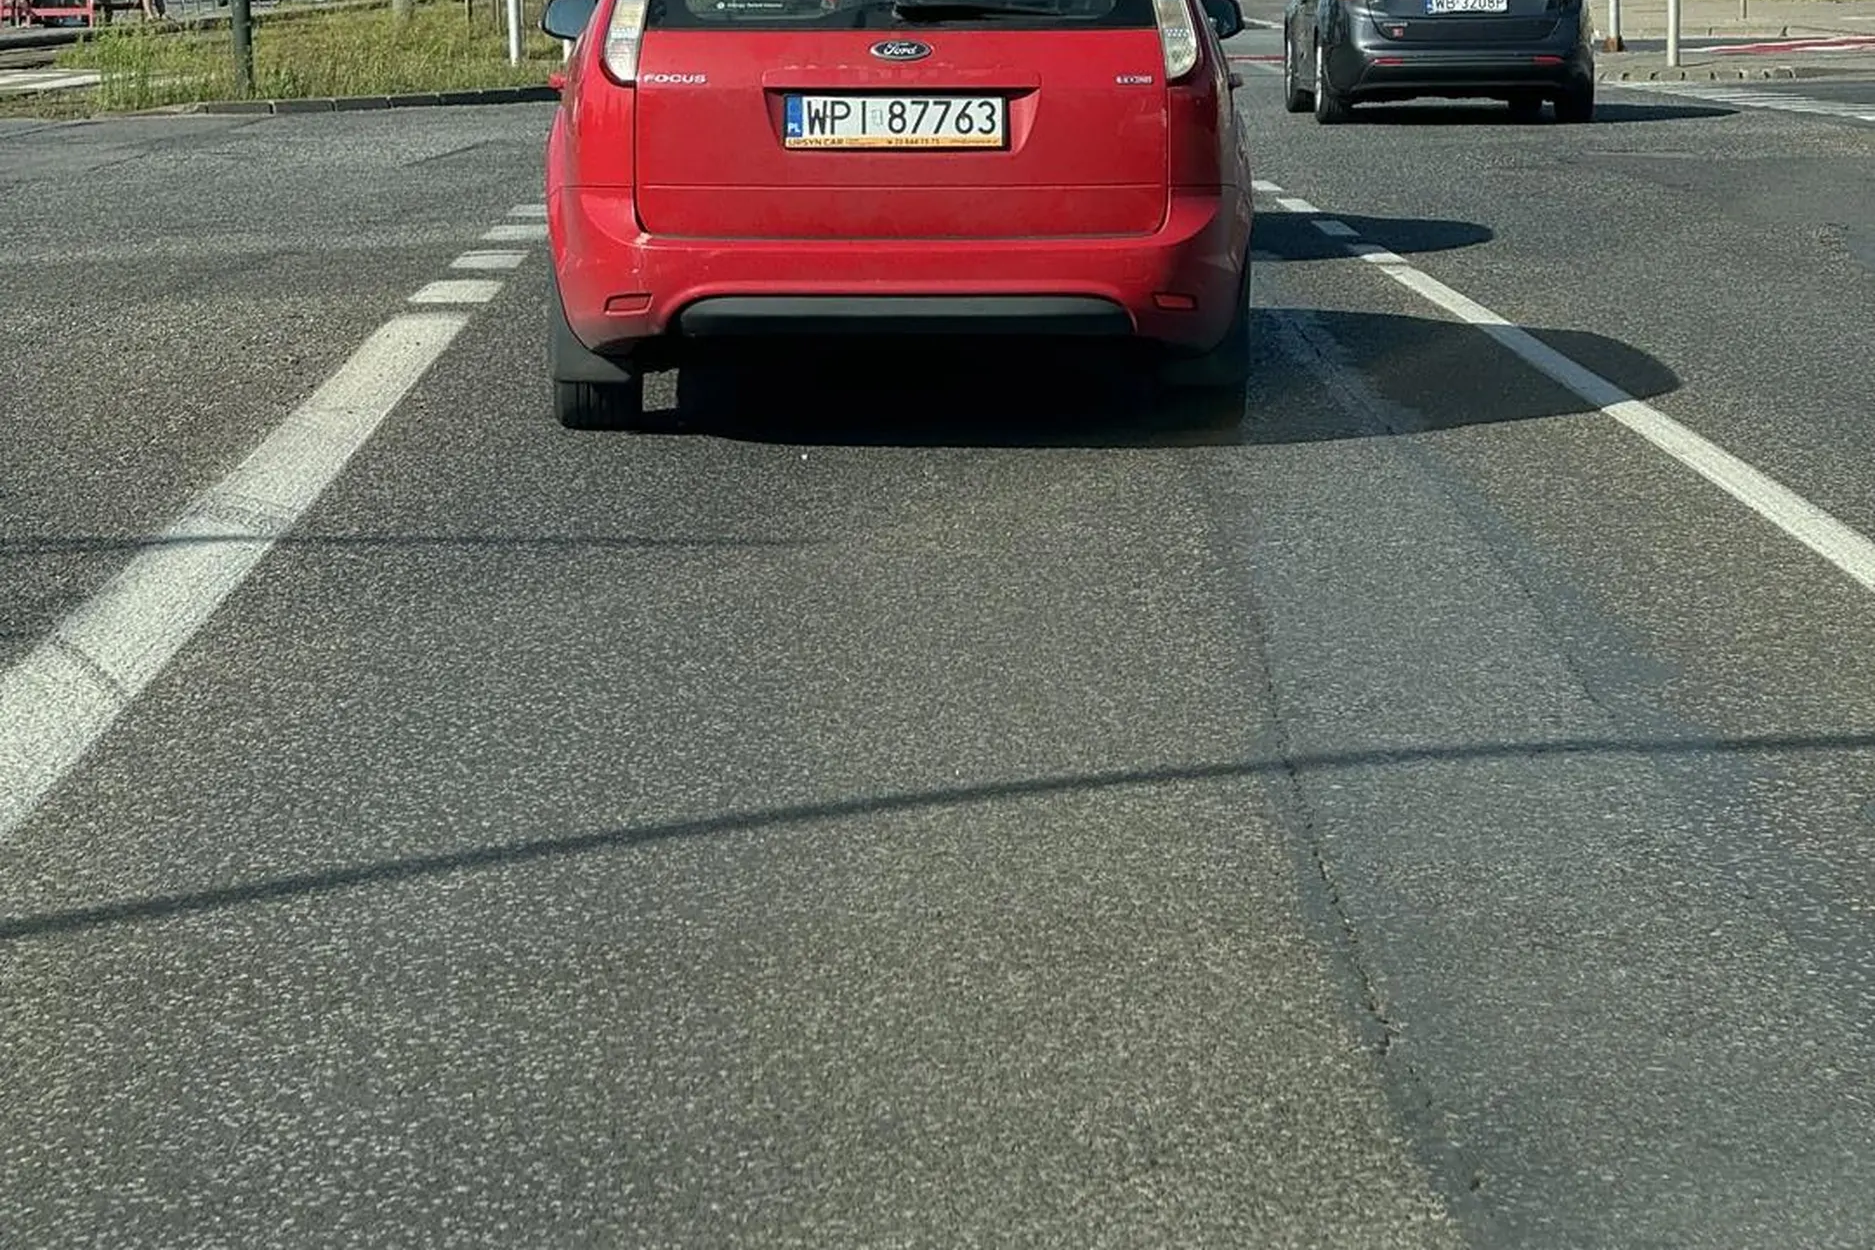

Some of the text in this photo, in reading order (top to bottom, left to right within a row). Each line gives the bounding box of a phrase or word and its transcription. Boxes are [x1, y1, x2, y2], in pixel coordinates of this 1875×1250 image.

[643, 73, 706, 84] FOCUS
[806, 100, 996, 135] WPI 87763
[788, 123, 801, 133] PL
